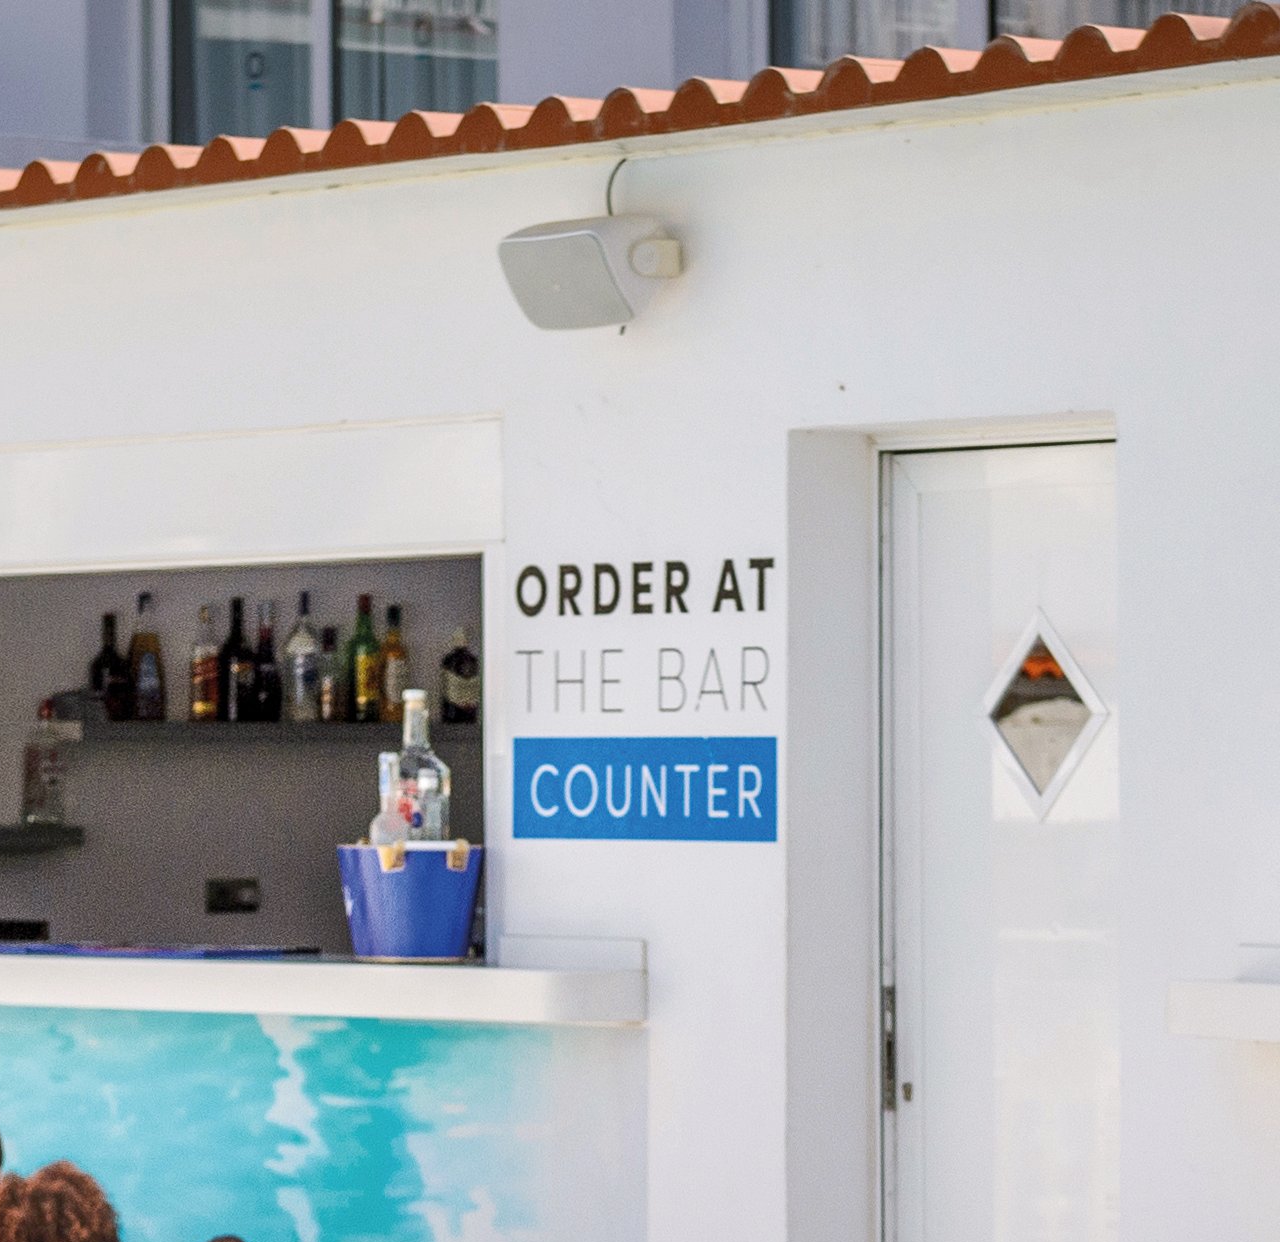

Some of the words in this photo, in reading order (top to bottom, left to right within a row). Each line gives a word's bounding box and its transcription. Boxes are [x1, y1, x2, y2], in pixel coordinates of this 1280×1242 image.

[515, 560, 690, 618] ORDER
[712, 557, 775, 613] AT
[515, 648, 624, 714] THE
[657, 645, 770, 713] BAR
[530, 763, 763, 818] COUNTER
